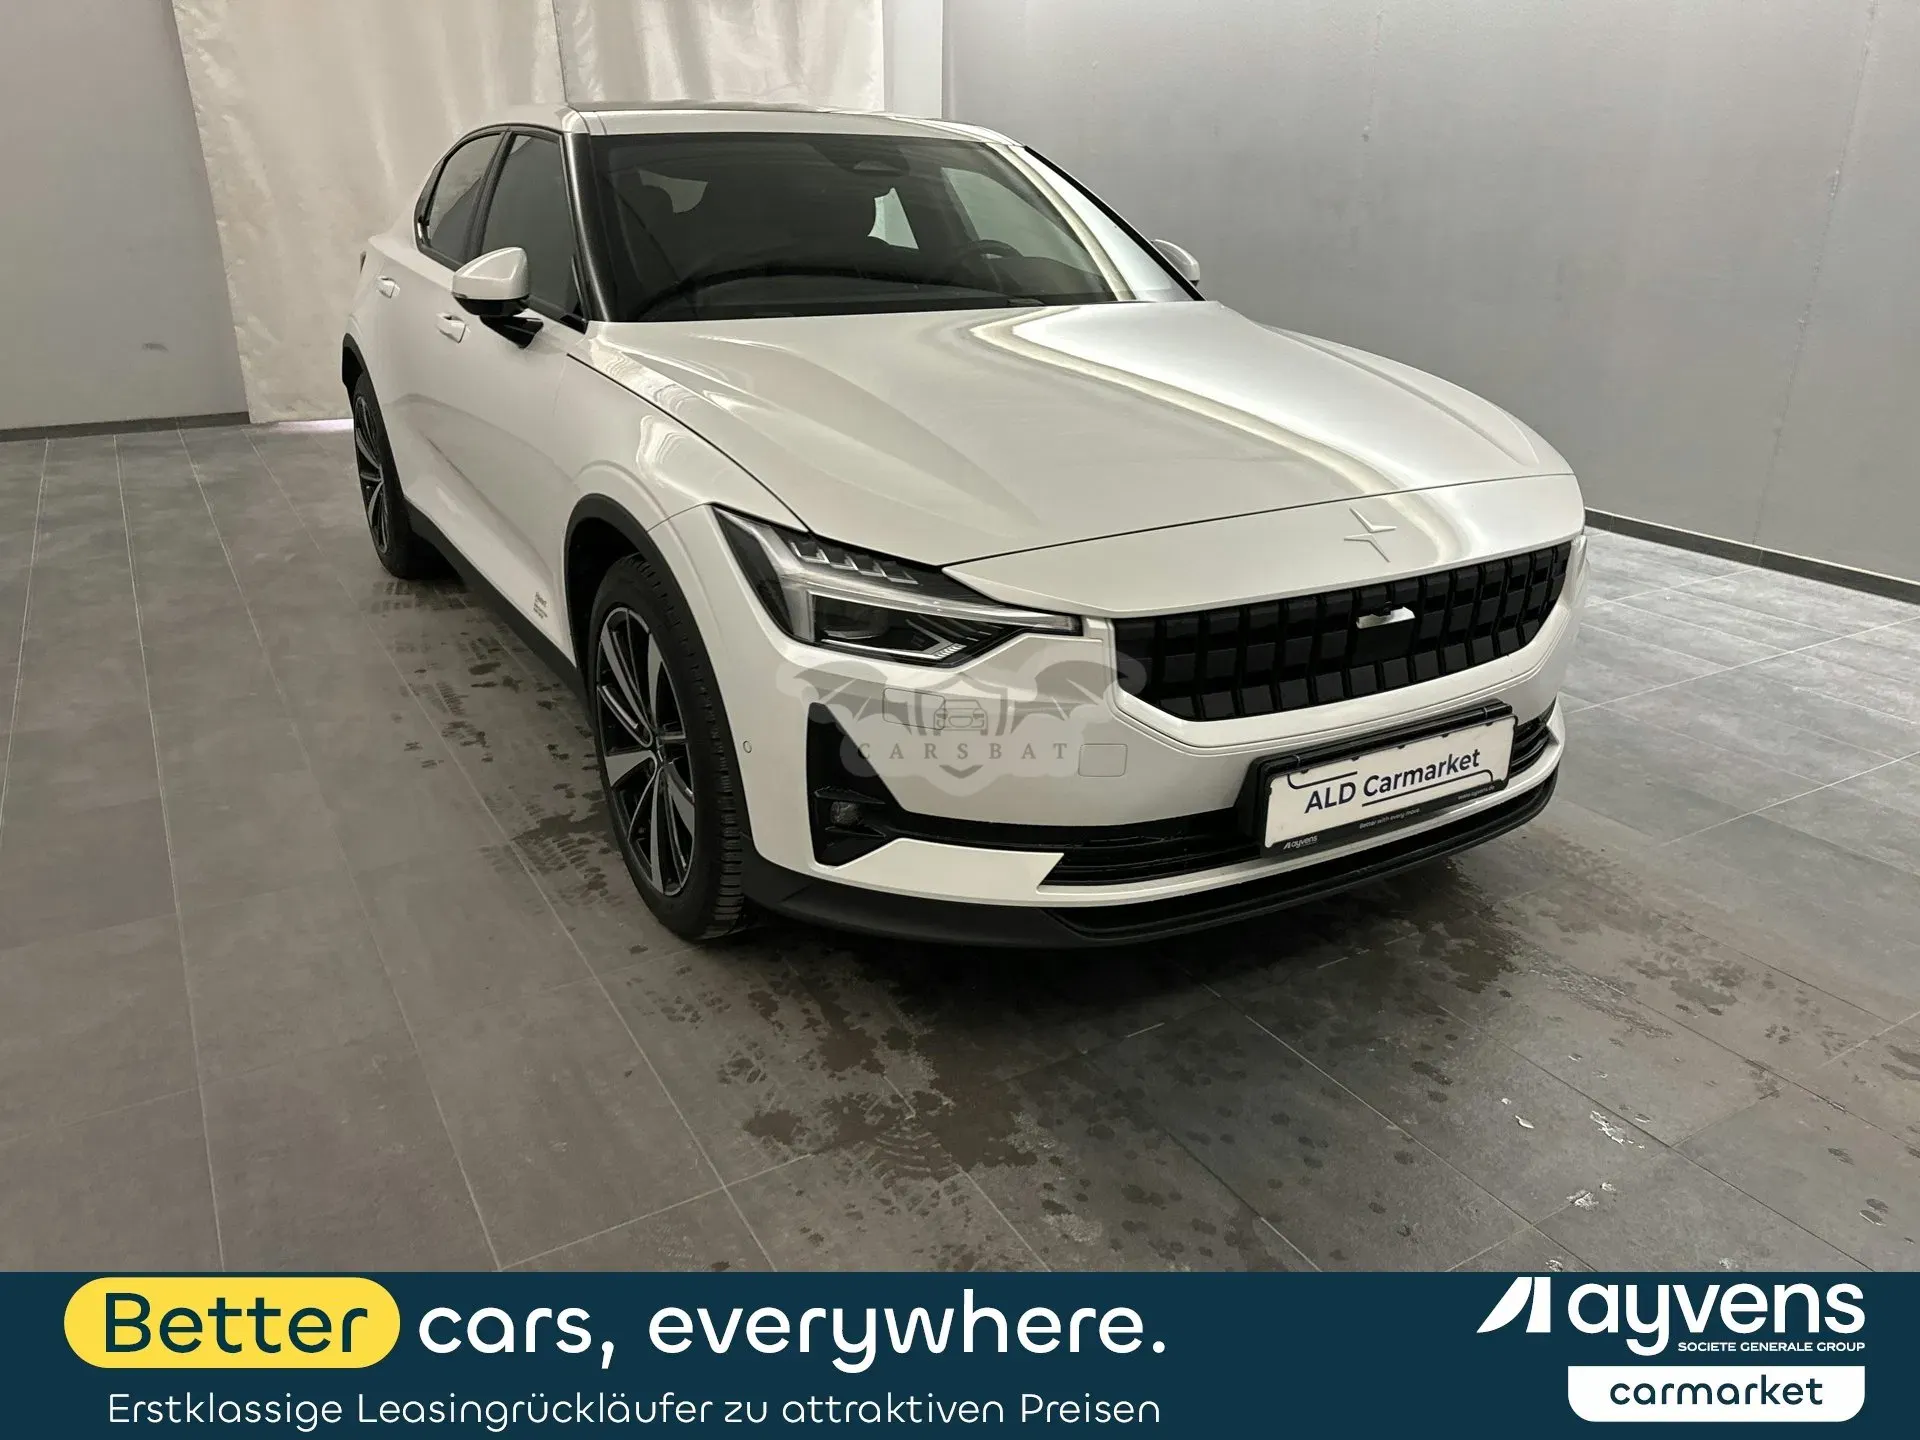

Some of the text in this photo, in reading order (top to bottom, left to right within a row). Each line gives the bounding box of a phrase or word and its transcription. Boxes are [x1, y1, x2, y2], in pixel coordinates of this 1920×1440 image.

[1304, 749, 1480, 814] ALD Carmarket
[1291, 835, 1318, 849] ayvens
